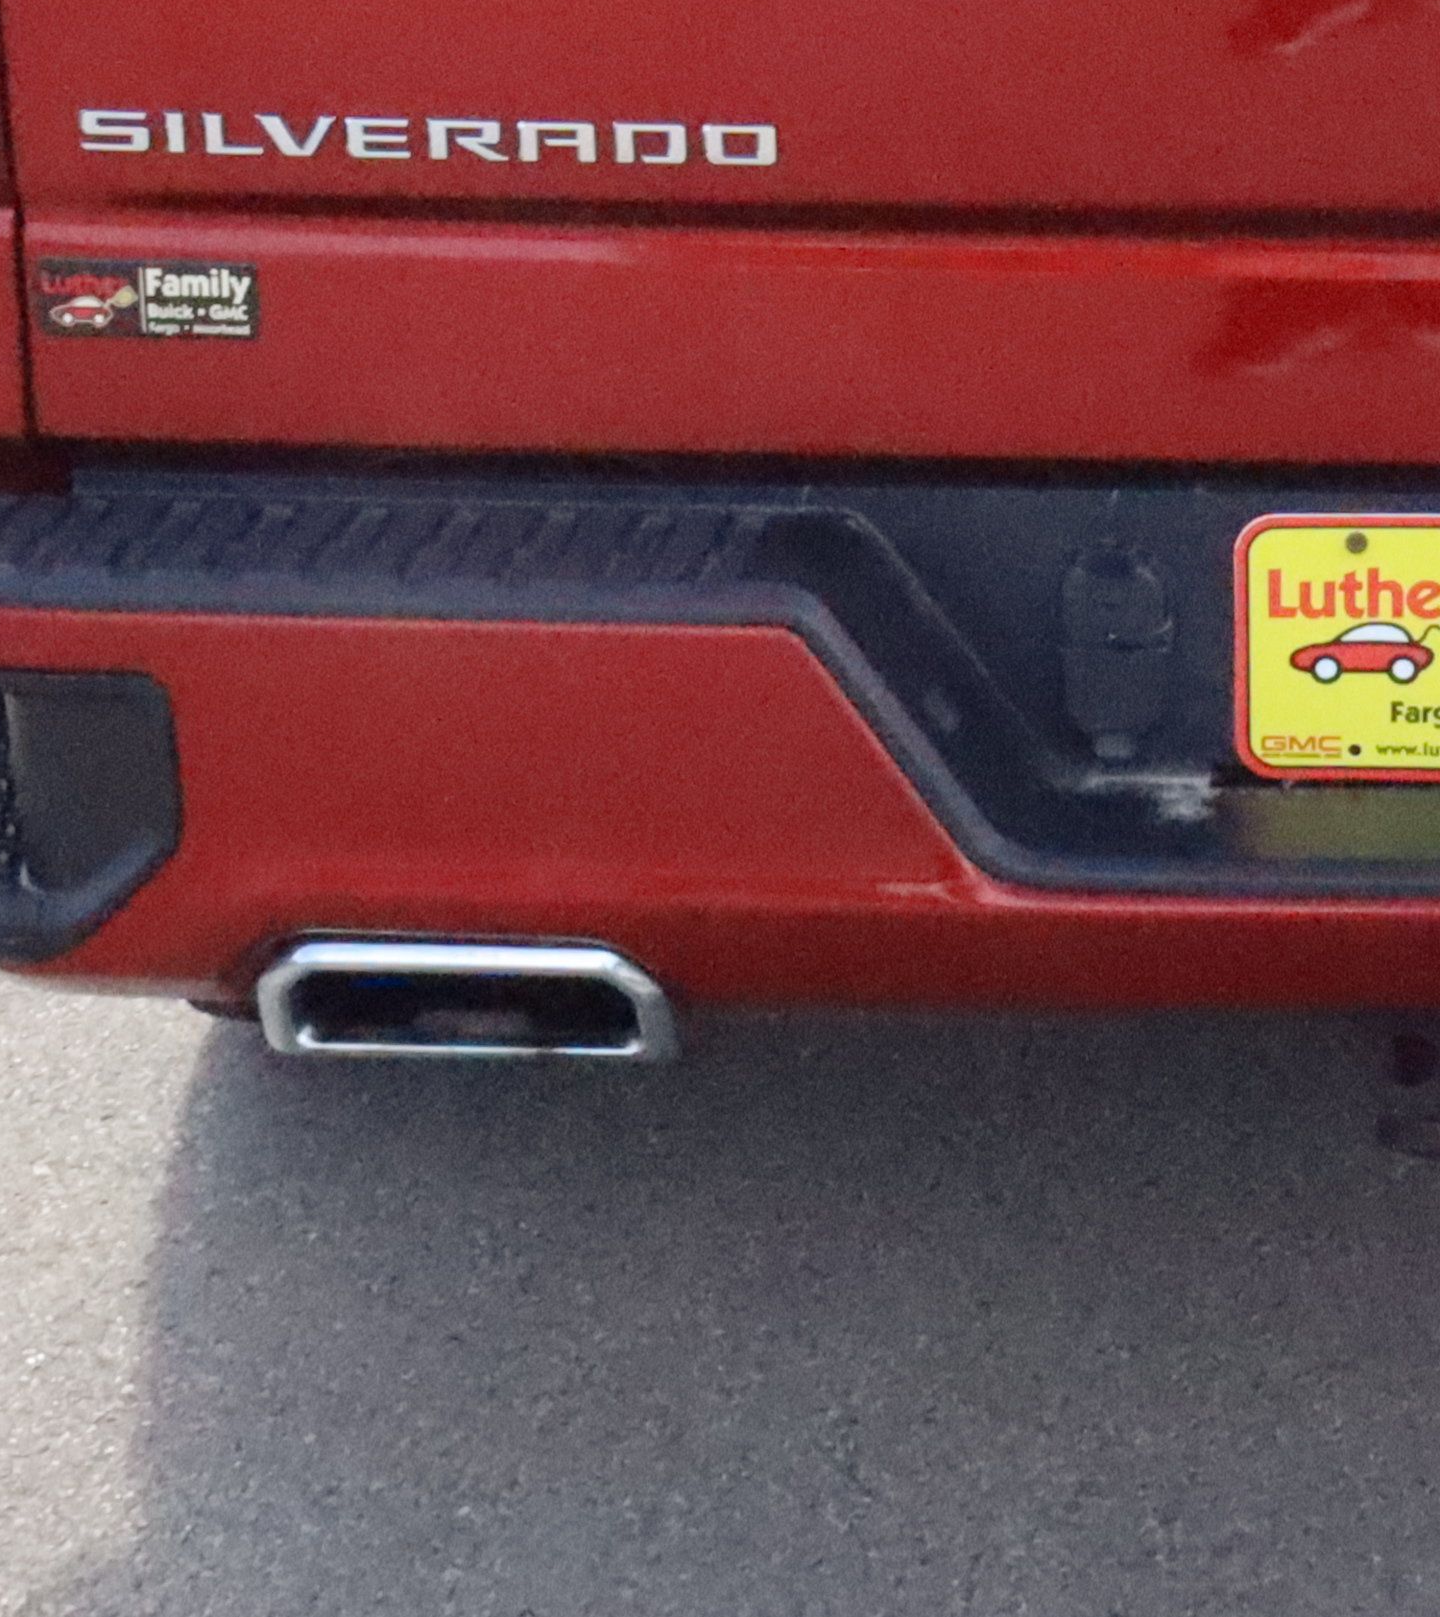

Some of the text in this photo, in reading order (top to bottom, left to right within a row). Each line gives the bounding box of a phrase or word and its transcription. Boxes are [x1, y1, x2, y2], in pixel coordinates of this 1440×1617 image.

[78, 108, 778, 166] SILVERADO
[145, 267, 251, 304] Family
[147, 303, 249, 321] Buick GMC
[1261, 736, 1343, 753] GMC
